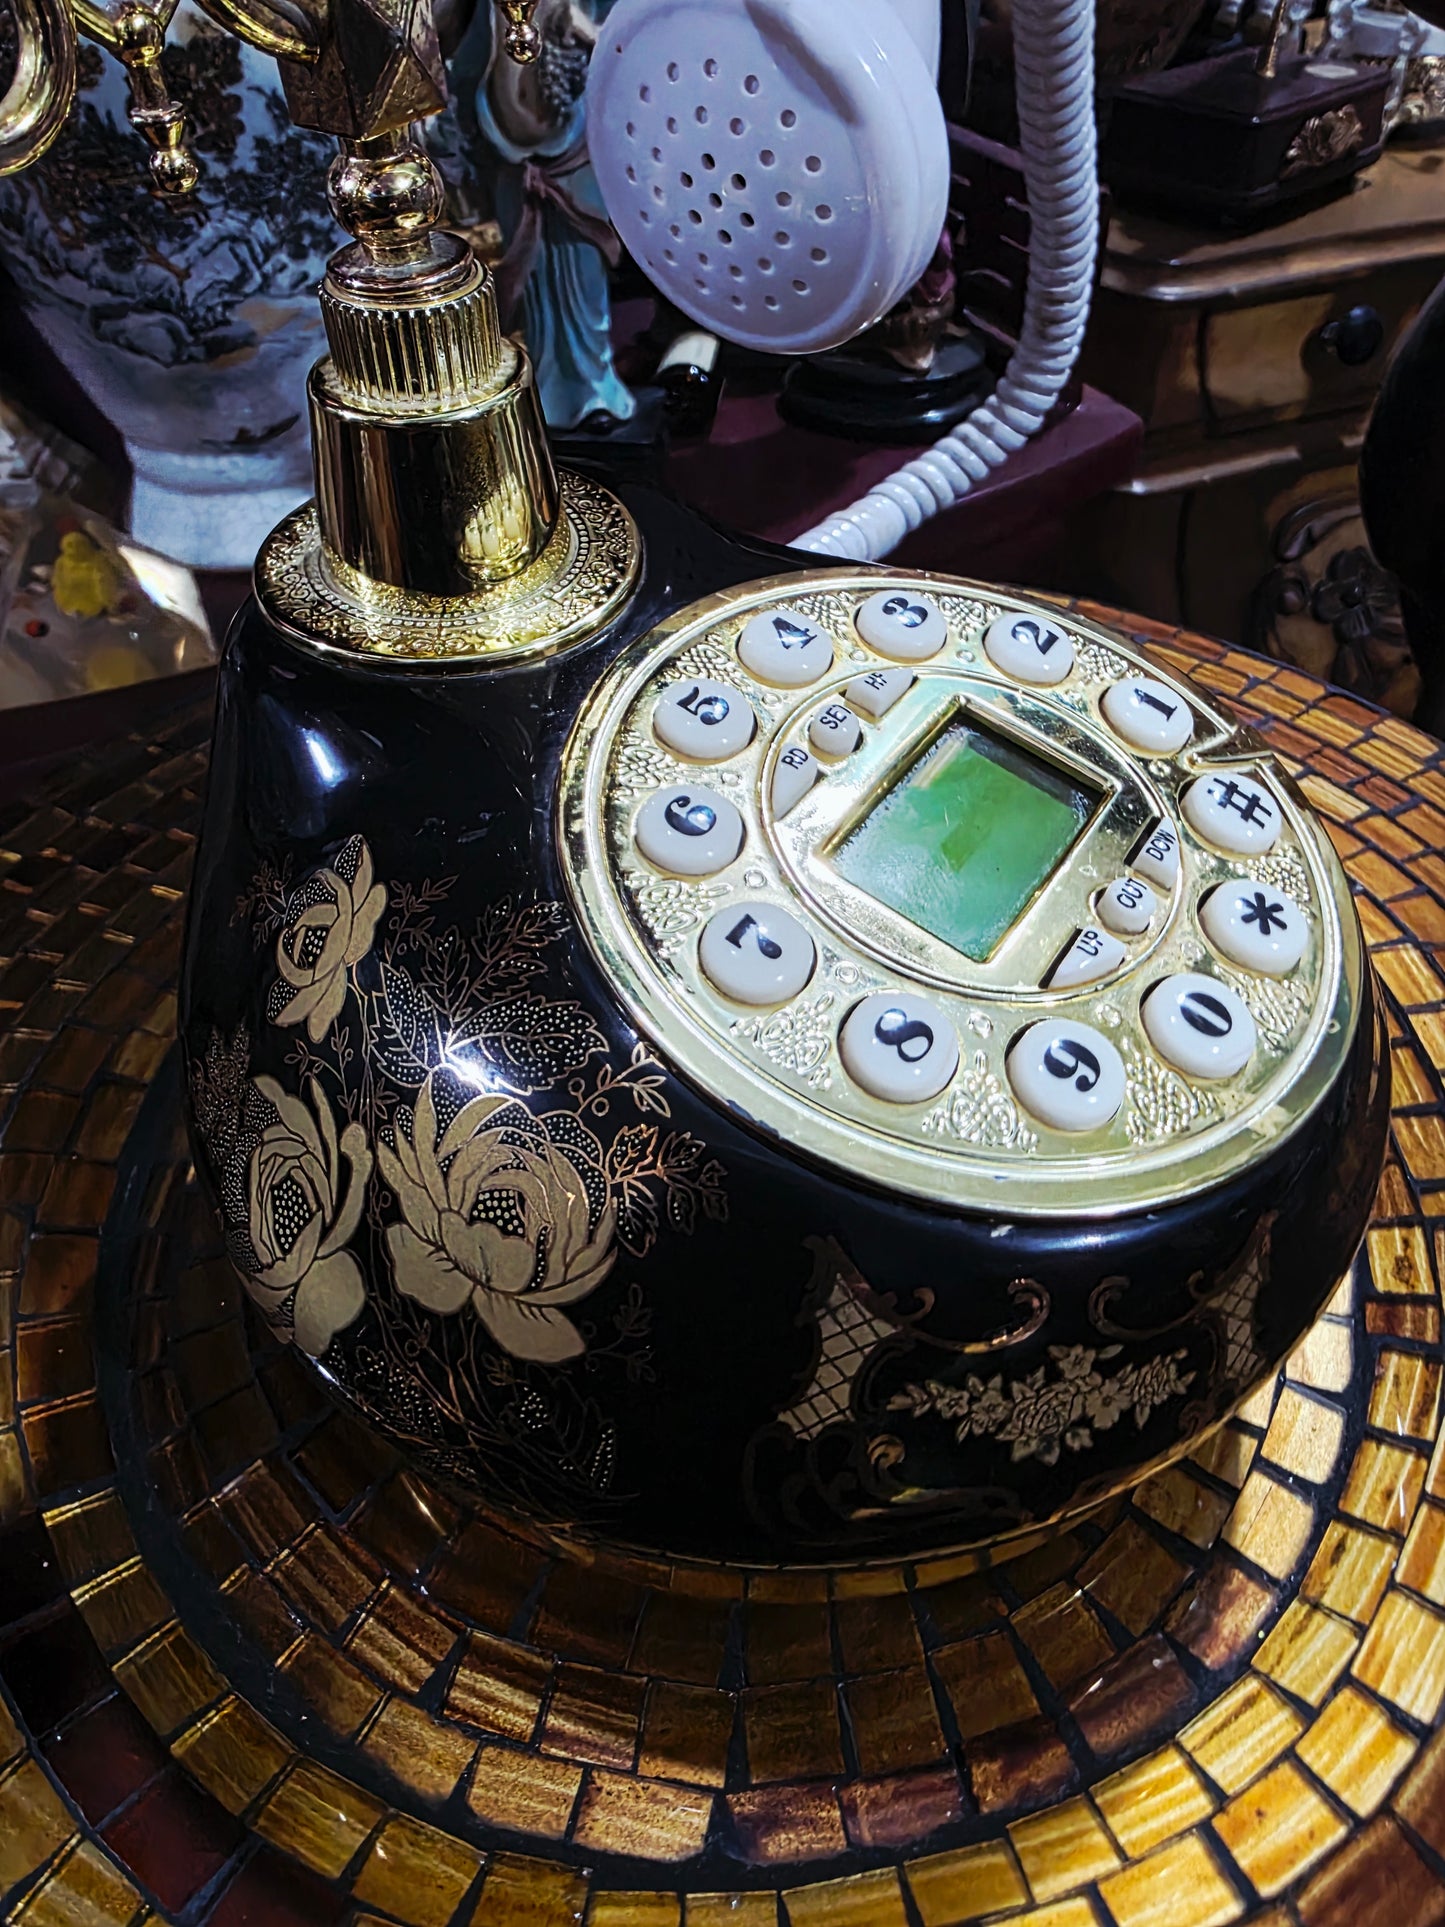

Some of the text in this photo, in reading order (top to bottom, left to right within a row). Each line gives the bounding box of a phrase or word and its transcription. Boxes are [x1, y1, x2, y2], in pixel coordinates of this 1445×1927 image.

[883, 596, 929, 627] 3
[773, 616, 819, 649] 4
[1011, 621, 1060, 655] 2
[677, 686, 729, 726] 5
[820, 704, 852, 729] SET
[1135, 687, 1178, 721] 1
[781, 747, 809, 769] RD
[665, 796, 716, 836] 6
[1208, 778, 1273, 829] #
[1116, 878, 1147, 909] OUT
[725, 914, 782, 959] 7
[1076, 930, 1103, 956] UP
[1181, 993, 1232, 1037] 0
[875, 1009, 933, 1062] 8
[1044, 1040, 1100, 1092] 9
